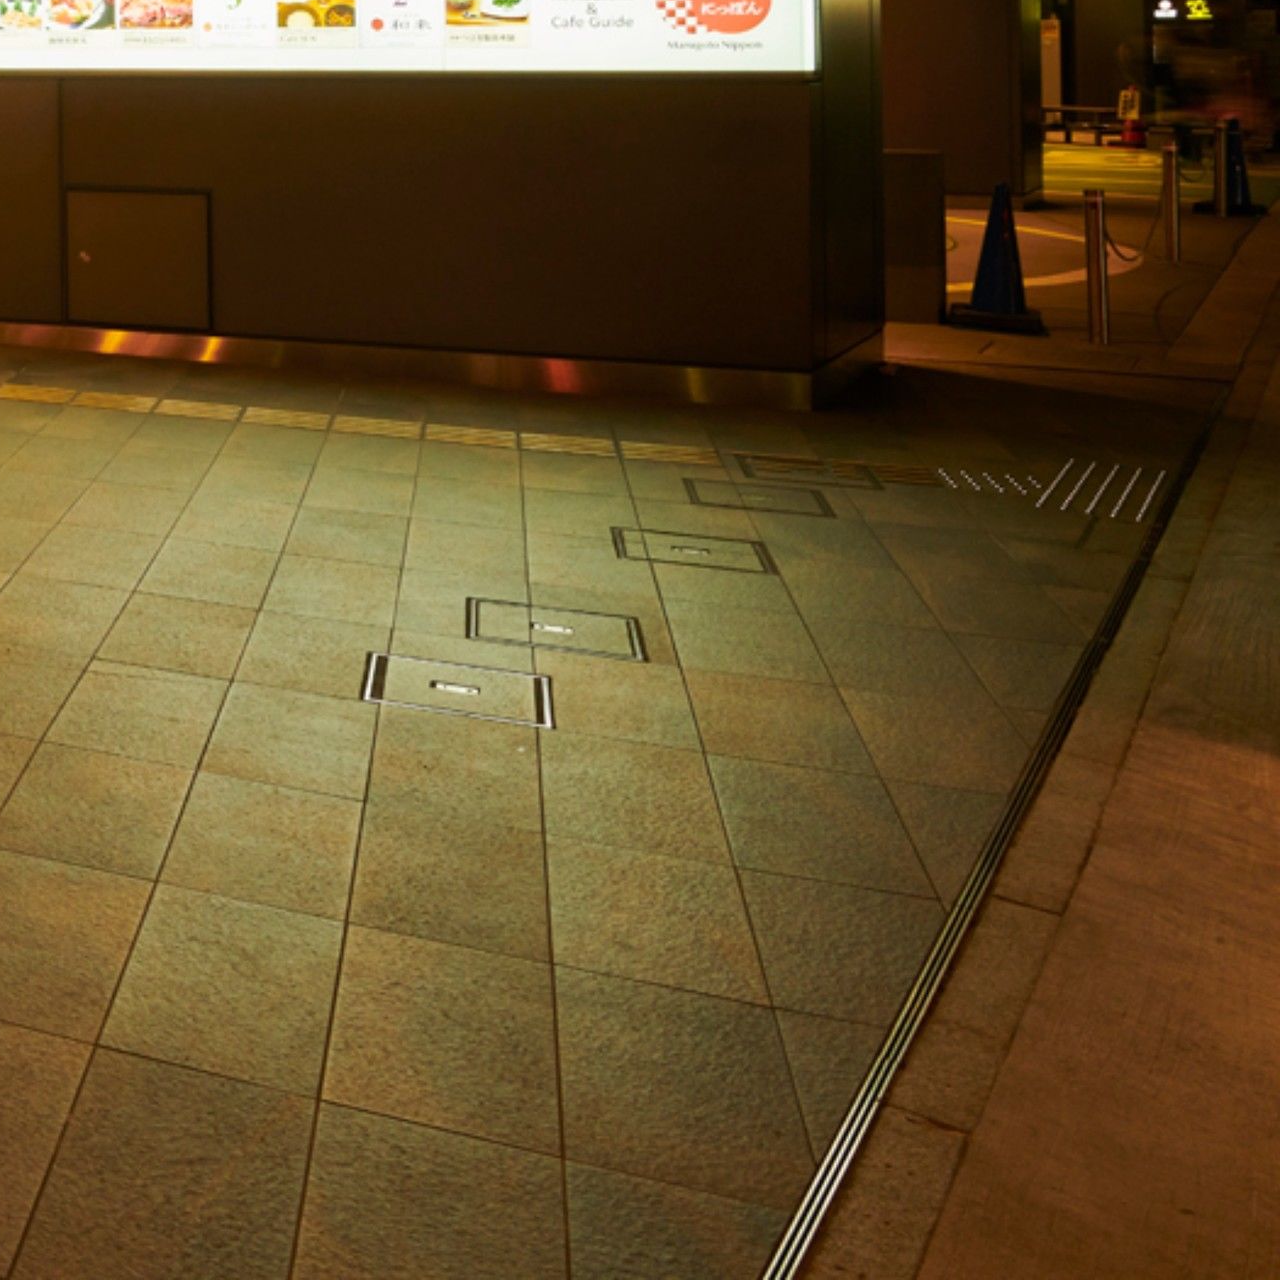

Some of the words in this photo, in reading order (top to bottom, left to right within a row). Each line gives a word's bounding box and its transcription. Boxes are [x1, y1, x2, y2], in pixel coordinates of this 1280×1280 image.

[701, 0, 763, 17] にっぽん
[589, 14, 634, 29] Guide
